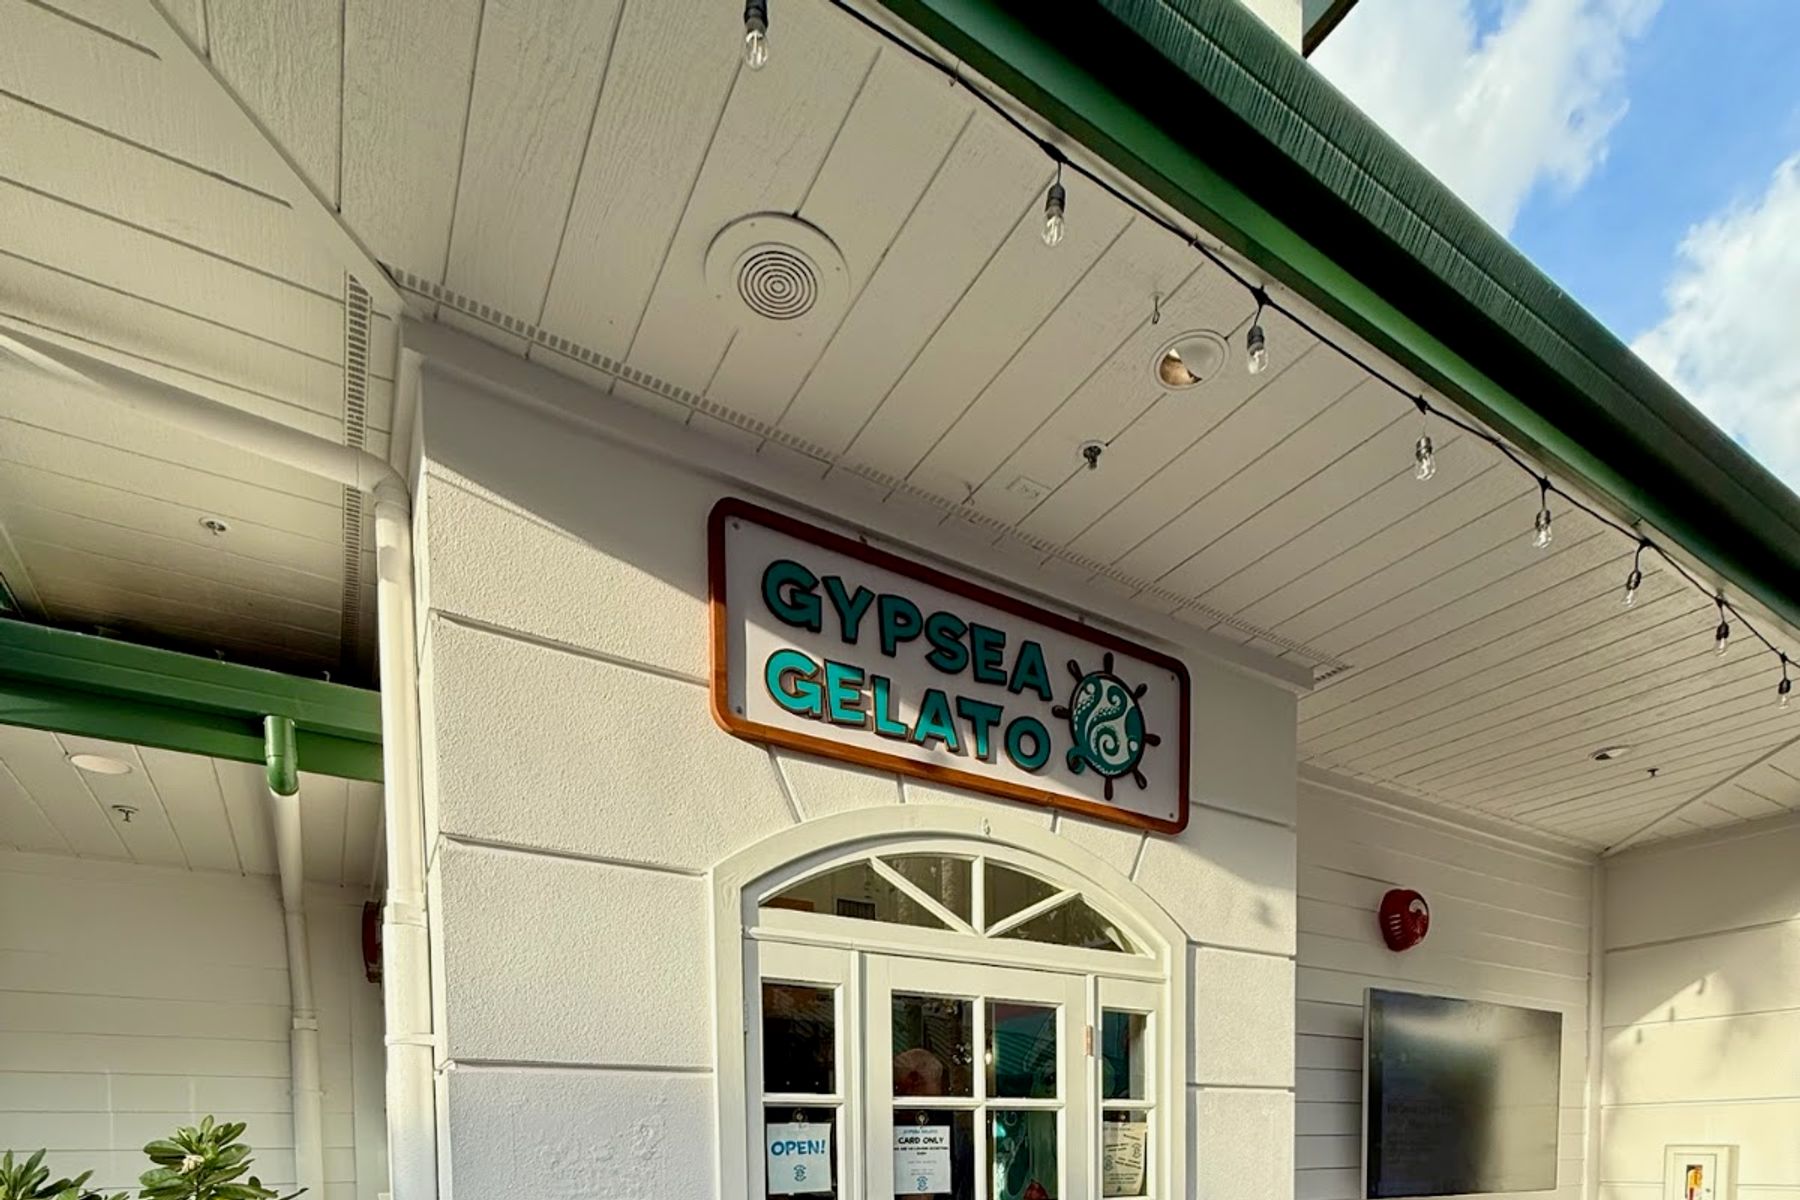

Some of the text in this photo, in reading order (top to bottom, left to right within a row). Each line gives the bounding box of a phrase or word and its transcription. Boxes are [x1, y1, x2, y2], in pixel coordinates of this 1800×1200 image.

[761, 559, 1053, 702] GYPSEA
[764, 649, 1052, 772] GELATO
[771, 1139, 825, 1156] OPEN!
[898, 1136, 944, 1145] CARD ONLY
